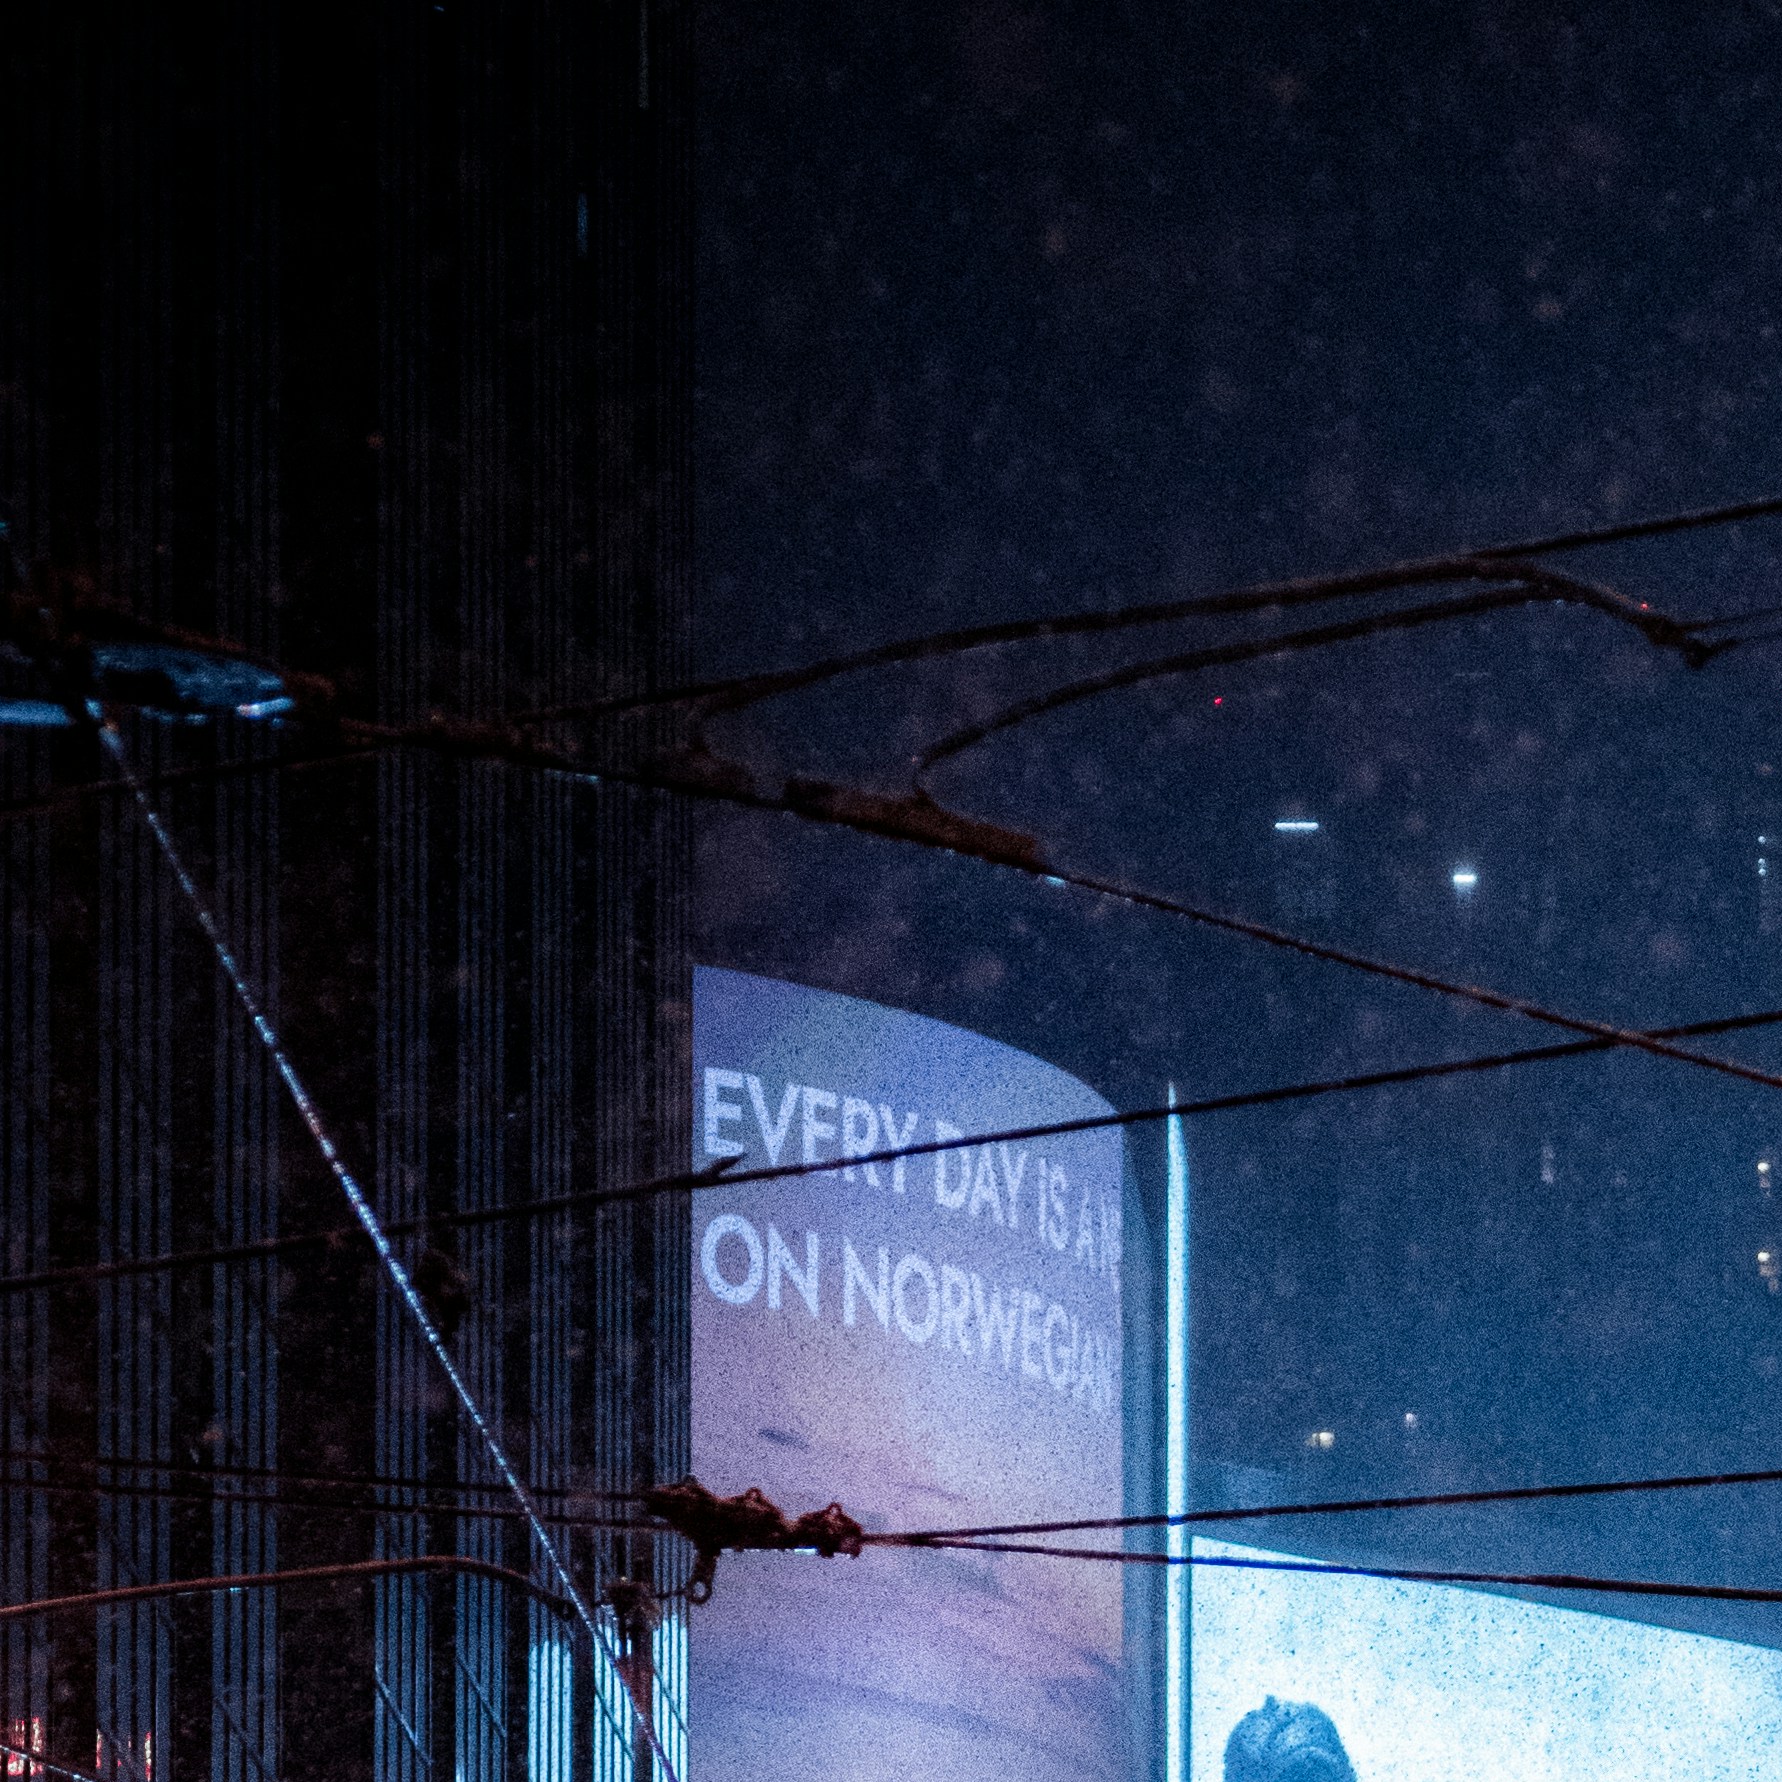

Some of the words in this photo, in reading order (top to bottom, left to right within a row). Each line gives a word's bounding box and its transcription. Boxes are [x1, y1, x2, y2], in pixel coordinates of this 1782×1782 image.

[704, 1067, 918, 1193] EVERY
[935, 1121, 1027, 1228] DAY
[1040, 1157, 1069, 1250] IS
[702, 1214, 819, 1317] ON
